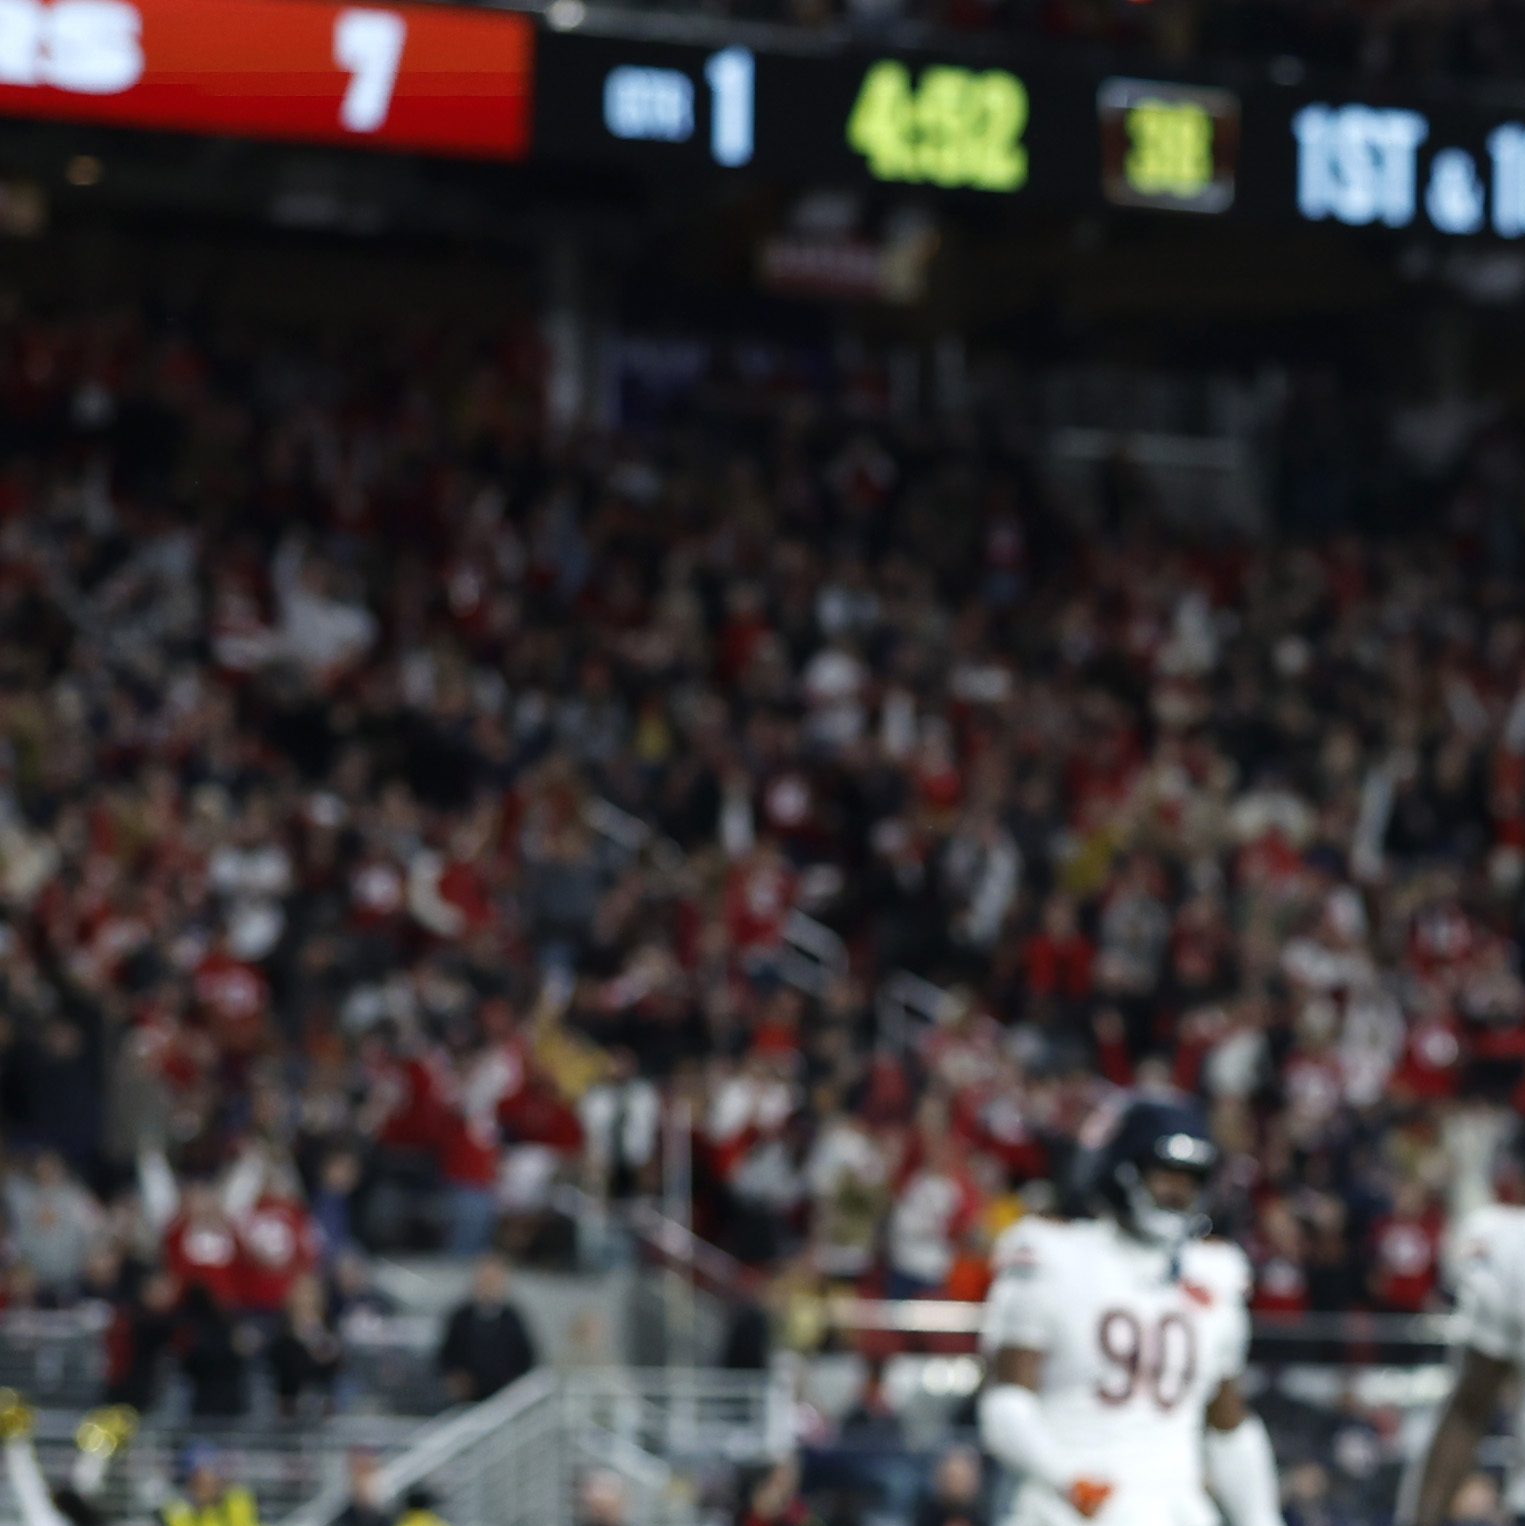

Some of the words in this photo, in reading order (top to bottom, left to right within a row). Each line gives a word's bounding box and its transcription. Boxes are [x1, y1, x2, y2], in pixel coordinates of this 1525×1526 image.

[333, 8, 406, 132] 7
[704, 45, 755, 168] 1
[1293, 102, 1428, 228] 1ST
[1096, 1306, 1197, 1411] 90
